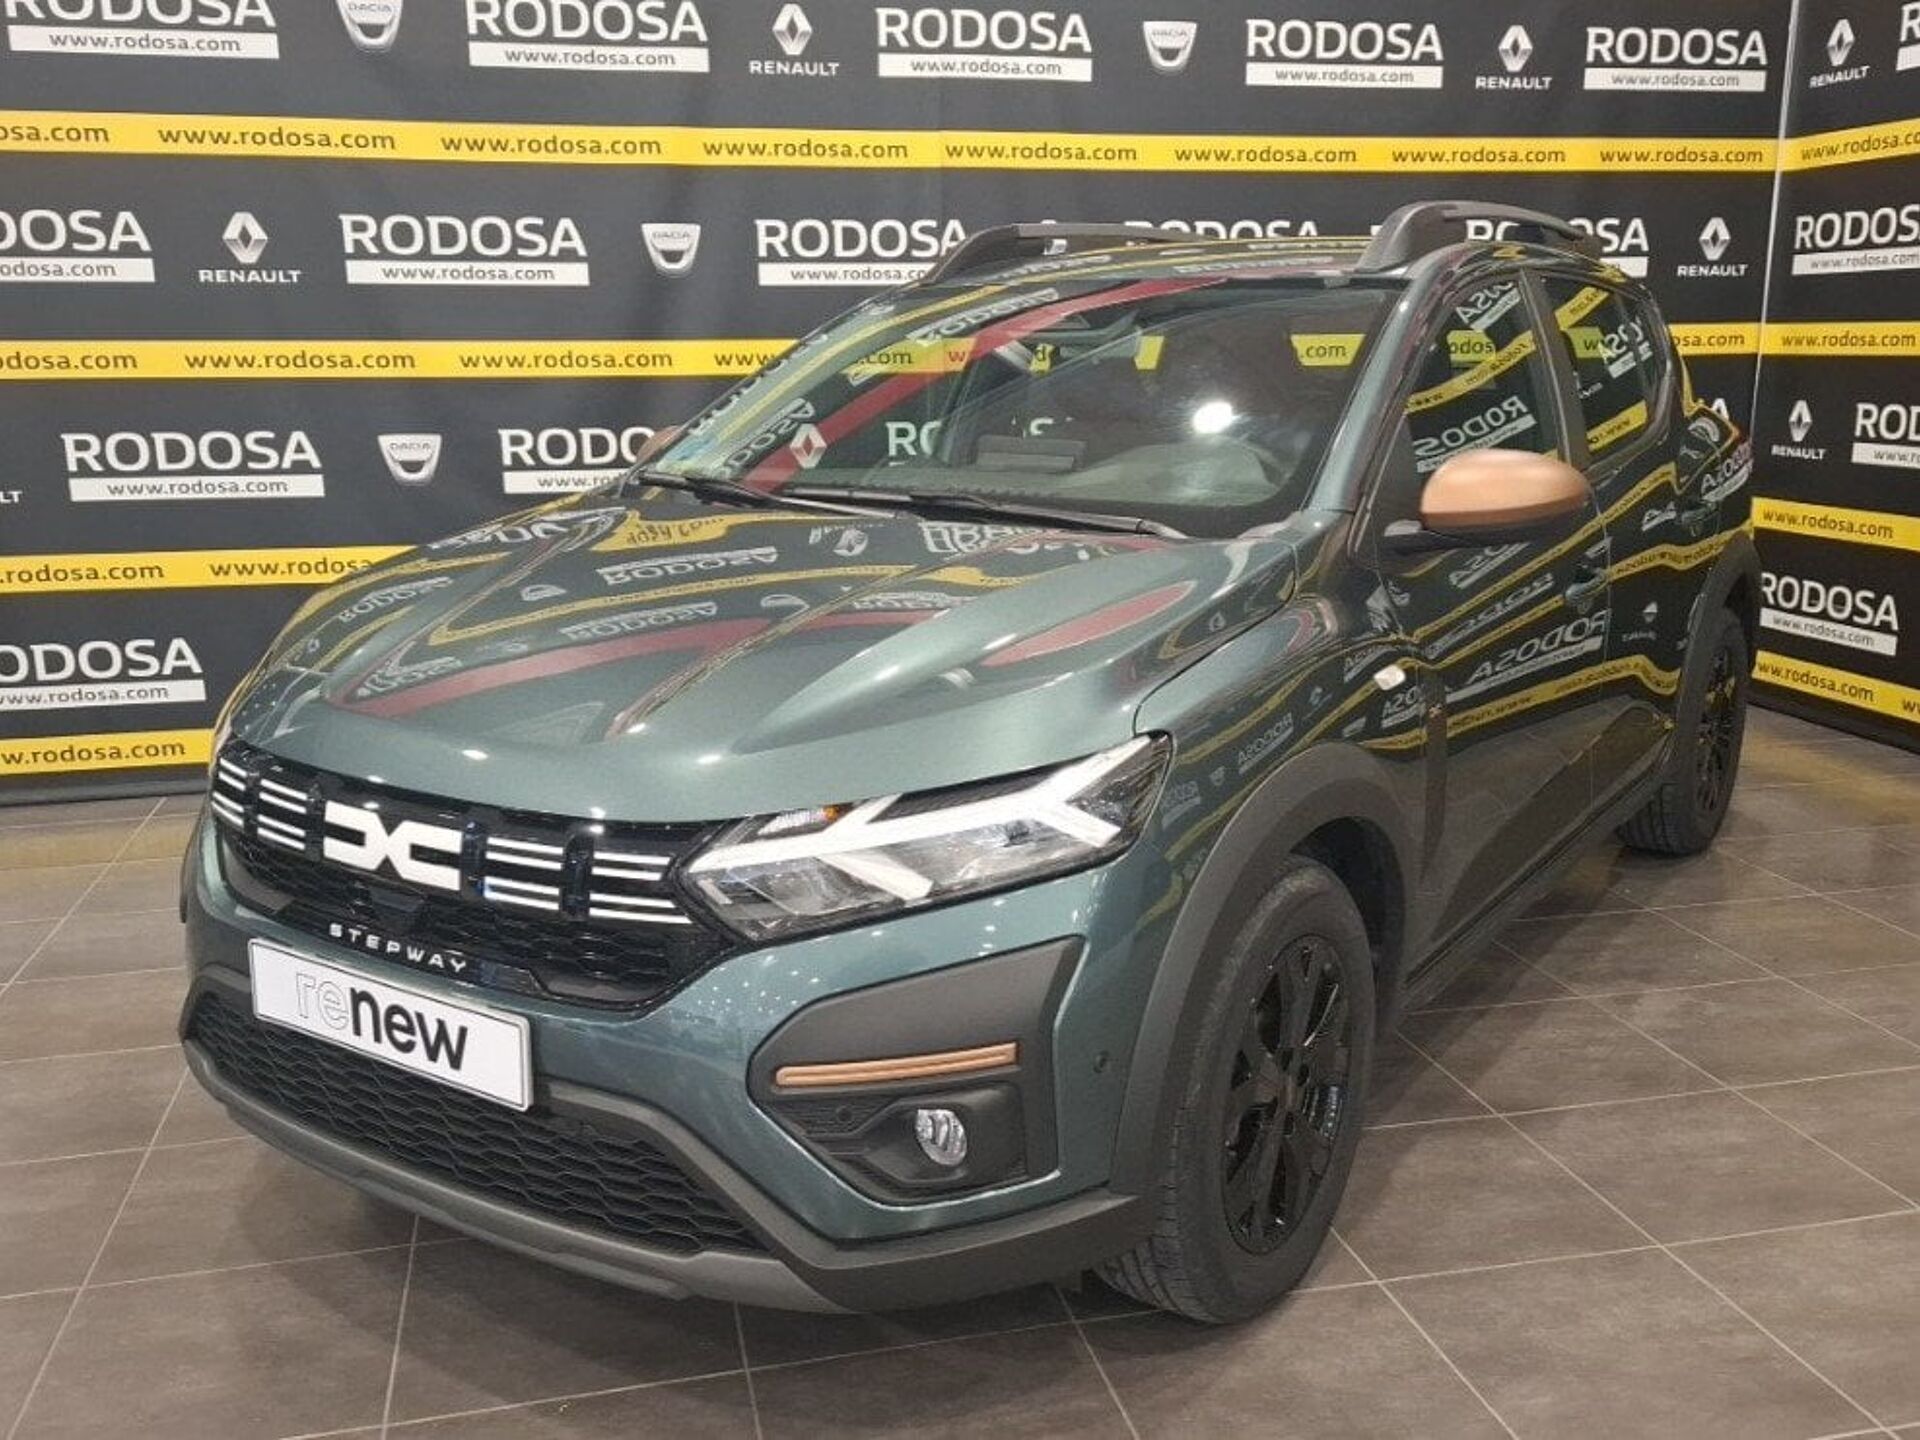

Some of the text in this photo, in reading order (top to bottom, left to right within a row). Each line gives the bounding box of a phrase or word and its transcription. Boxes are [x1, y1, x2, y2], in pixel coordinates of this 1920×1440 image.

[466, 0, 708, 42] RODOSA
[876, 8, 1092, 53] RODOSA
[48, 33, 242, 52] www.rodosa.com
[1245, 18, 1444, 62] RODOSA
[1586, 26, 1767, 66] RODOSA
[504, 48, 676, 66] www.rodosa.com
[910, 58, 1062, 75] www.rodosa.com
[748, 60, 840, 77] RENAULT
[1274, 67, 1415, 83] www.rodosa.com
[1808, 65, 1871, 89] RENAULT
[1475, 76, 1552, 90] RENAULT
[1611, 71, 1740, 87] www.rodosa.com
[158, 125, 396, 150] www.rodosa.com
[440, 133, 662, 155] www.rodosa.com
[703, 138, 908, 159] www.rodosa.com
[945, 141, 1137, 161] www.rodosa.com
[1173, 145, 1357, 163] www.rodosa.com
[1392, 146, 1566, 163] www.rodosa.com
[1600, 147, 1763, 163] www.rodosa.com
[338, 213, 589, 258] RODOSA
[754, 218, 967, 259] RODOSA
[198, 269, 302, 284] RENAULT
[381, 264, 556, 281] www.rodosa.com
[1676, 263, 1749, 278] RENAULT
[1781, 330, 1916, 348] www.rodosa.com
[185, 350, 415, 369] www.rodosa.com
[459, 350, 674, 369] www.rodosa.com
[61, 430, 322, 472] RODOSA
[1771, 444, 1827, 461] RENAULT
[106, 478, 289, 496] www.rodosa.com
[1762, 509, 1894, 539] www.rodosa.com
[1761, 572, 1899, 631] RODOSA
[1772, 614, 1876, 647] www.rodosa.com
[328, 922, 468, 974] STEPWAY
[295, 971, 469, 1072] renew
